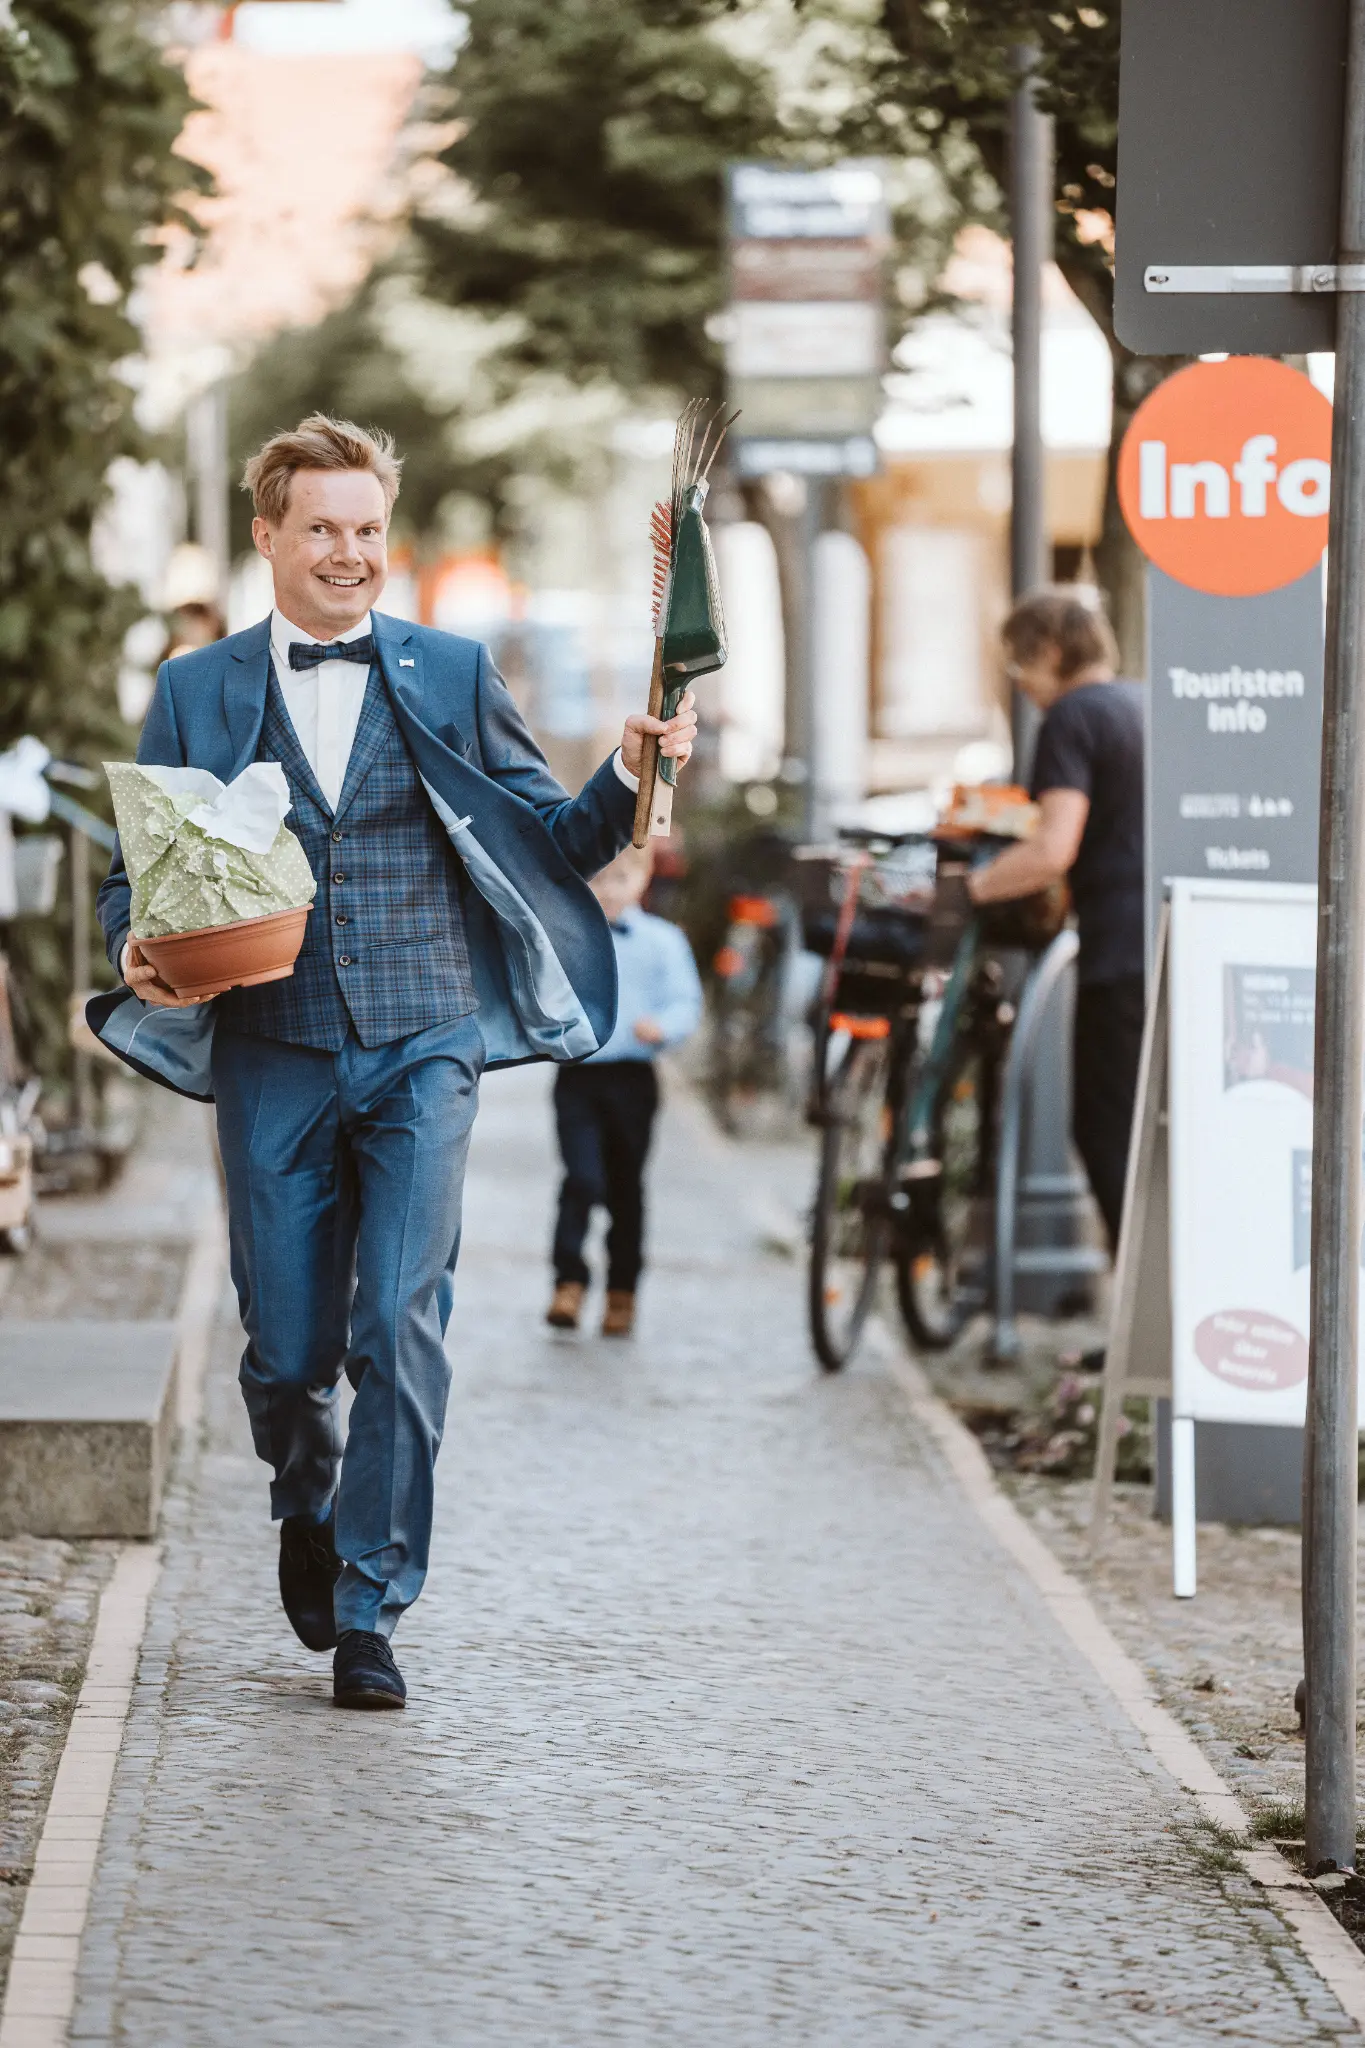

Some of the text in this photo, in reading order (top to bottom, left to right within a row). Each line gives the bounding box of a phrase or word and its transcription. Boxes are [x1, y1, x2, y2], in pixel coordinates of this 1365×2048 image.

[1139, 434, 1331, 519] Info
[1168, 665, 1304, 698] Touristen
[1207, 699, 1268, 734] Info
